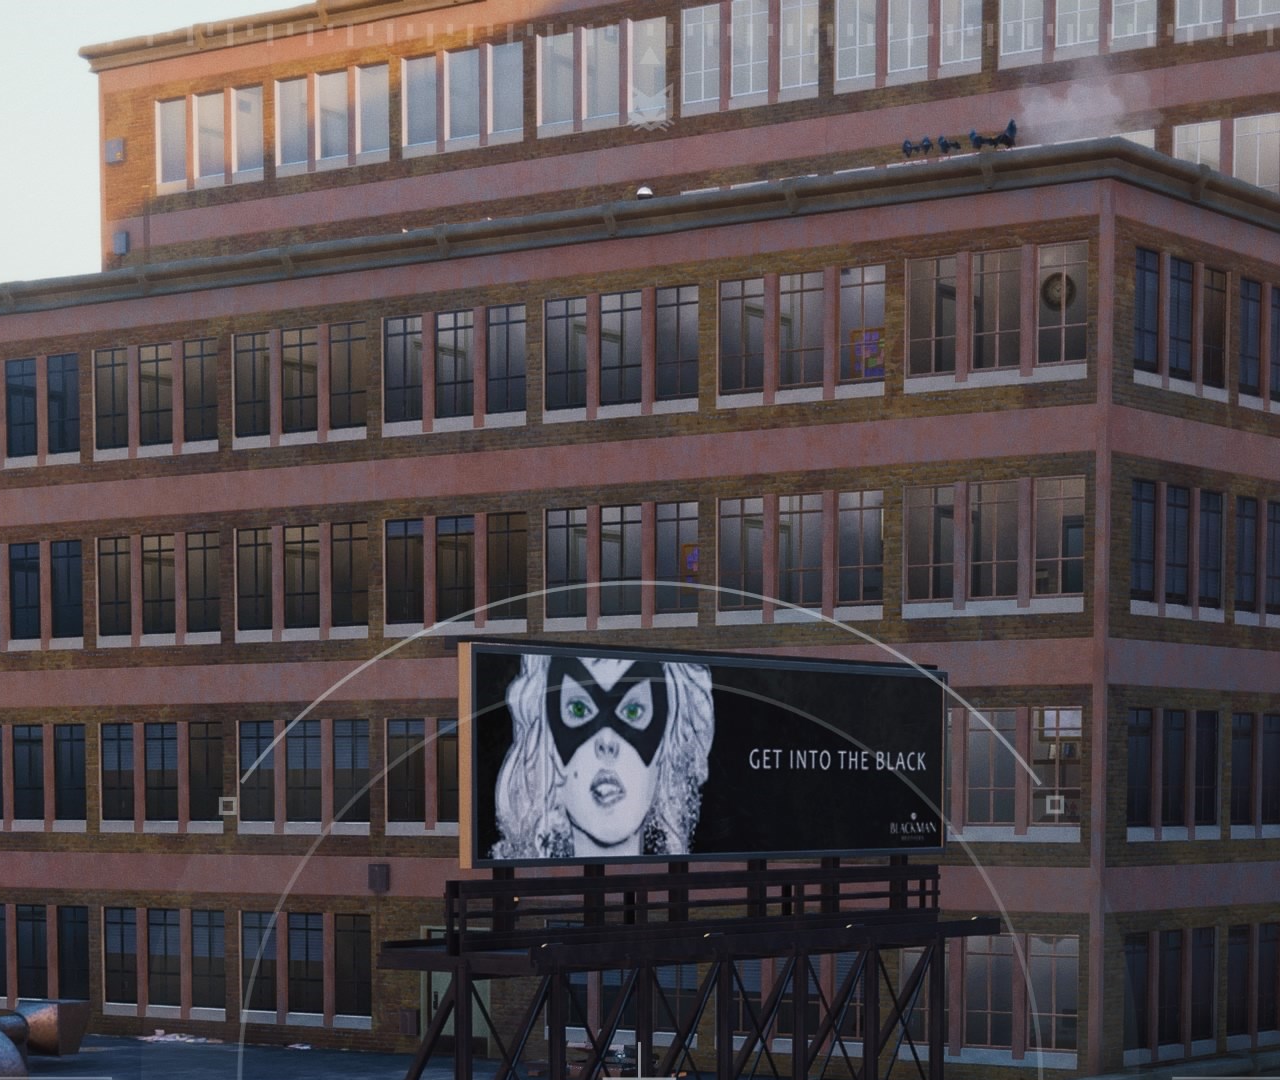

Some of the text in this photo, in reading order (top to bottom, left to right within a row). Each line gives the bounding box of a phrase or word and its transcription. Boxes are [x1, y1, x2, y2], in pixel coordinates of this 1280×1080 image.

[749, 748, 927, 771] GET INTO THE BLACK
[890, 821, 937, 834] BLACKMAN
